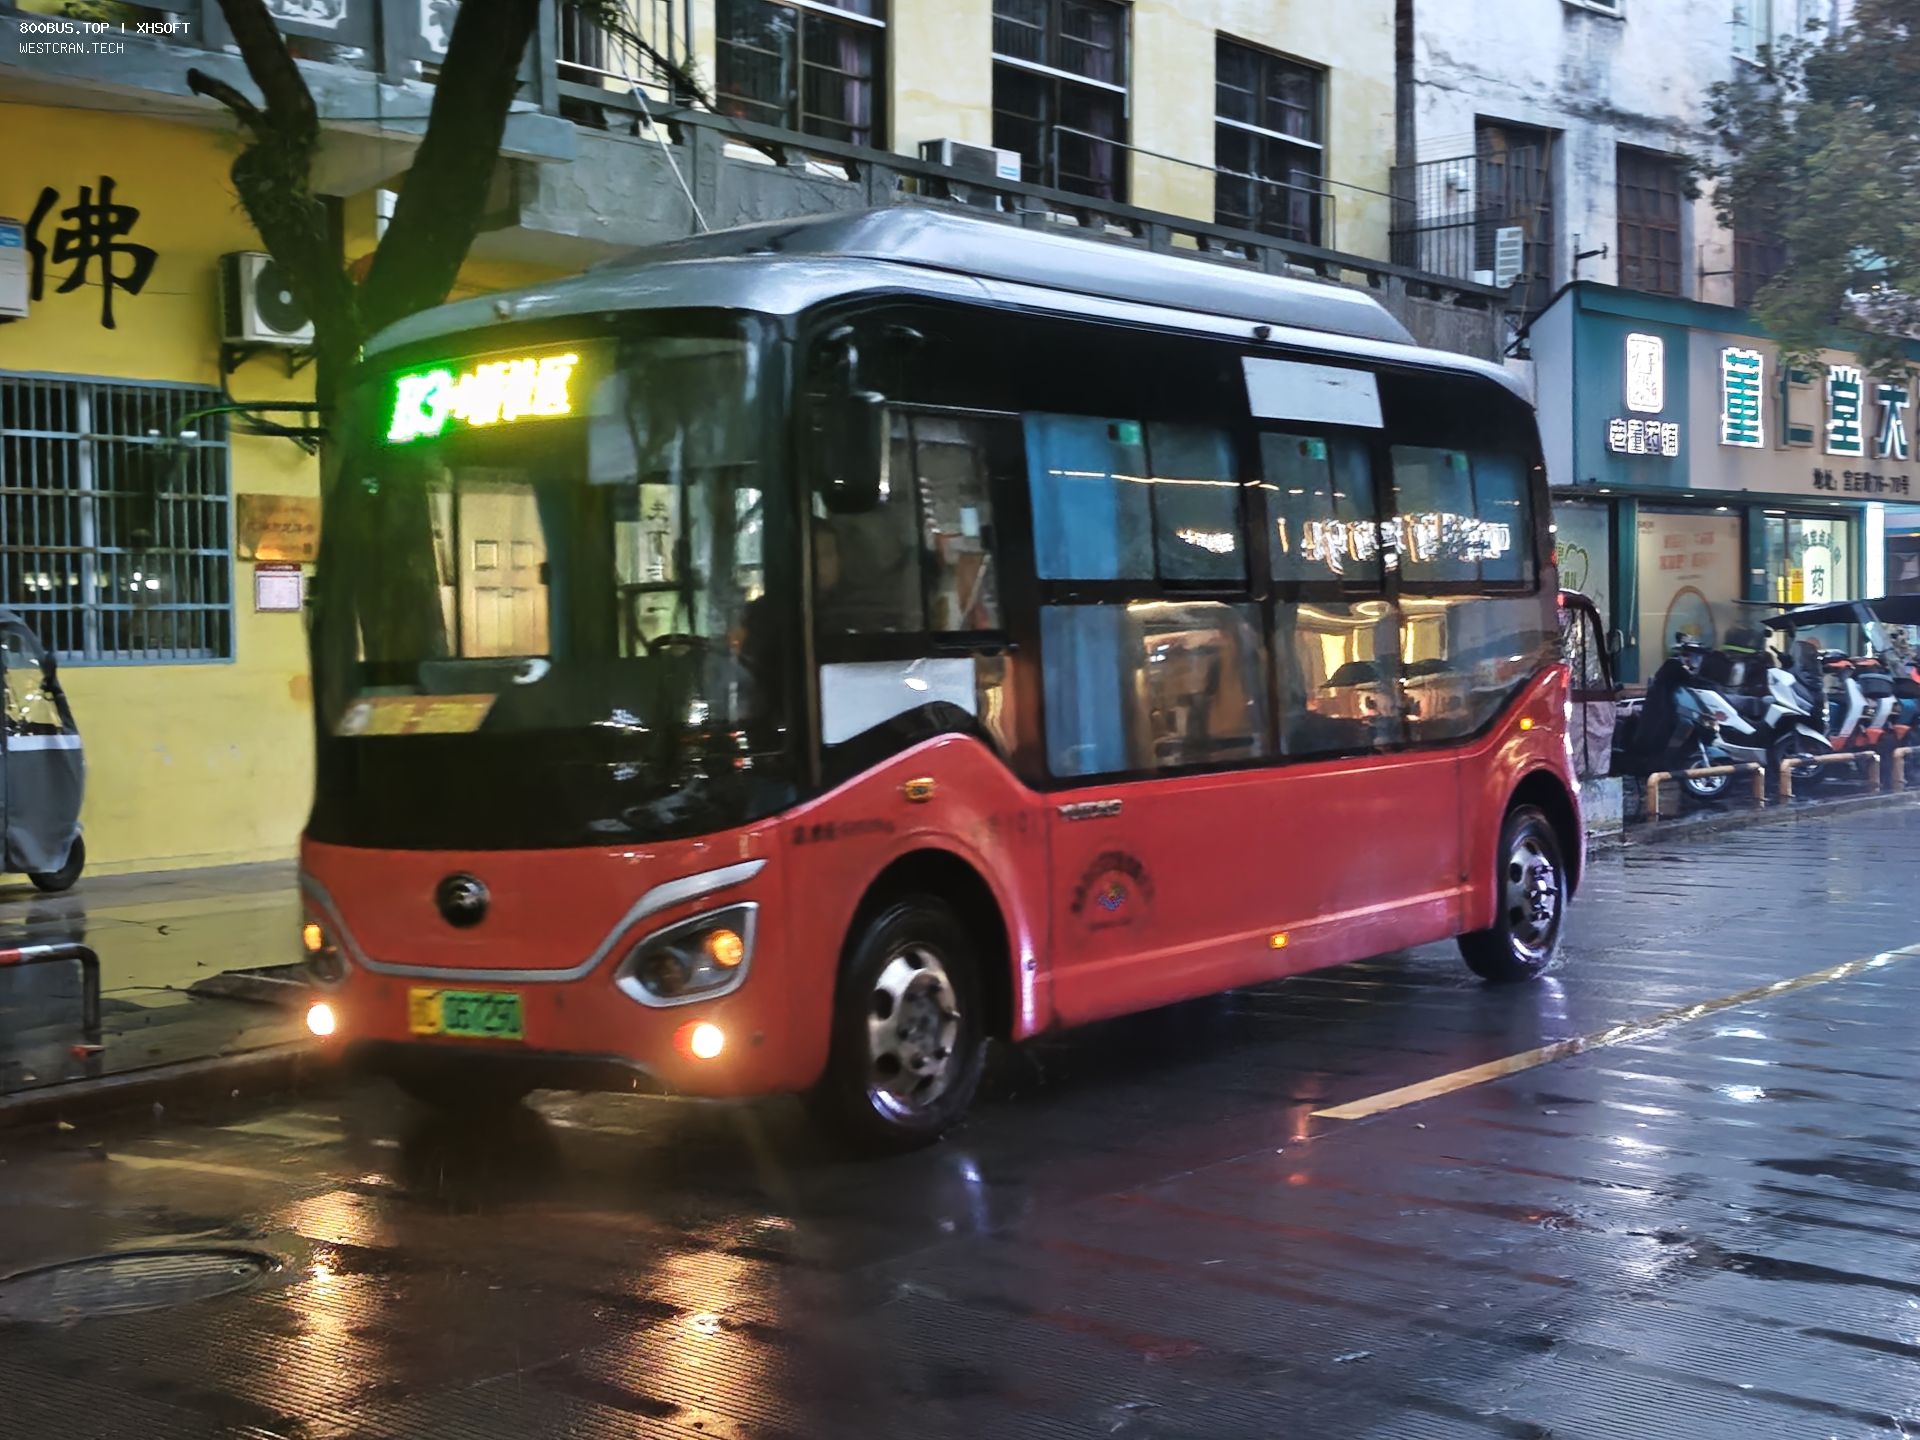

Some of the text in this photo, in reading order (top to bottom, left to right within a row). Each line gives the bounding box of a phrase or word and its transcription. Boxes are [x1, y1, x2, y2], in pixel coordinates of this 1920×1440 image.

[26, 175, 159, 330] 佛
[1720, 346, 1920, 461] 董仁堂大
